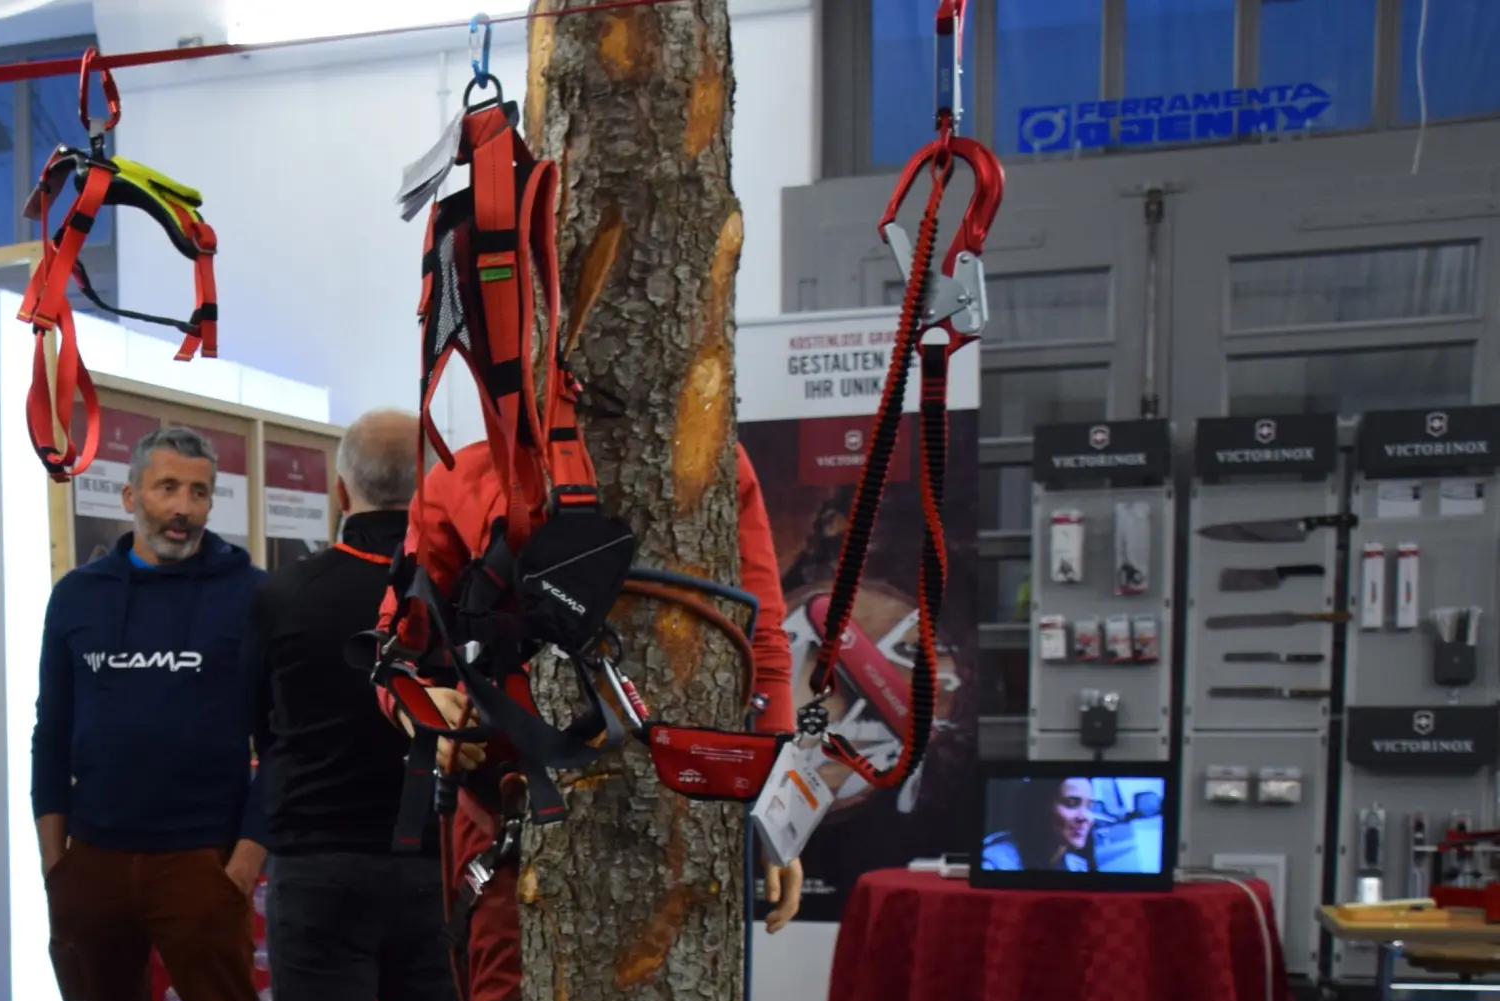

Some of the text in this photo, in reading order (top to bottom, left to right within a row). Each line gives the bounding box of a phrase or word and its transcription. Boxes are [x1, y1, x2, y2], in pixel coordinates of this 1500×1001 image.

[1076, 83, 1330, 123] FERRAMENTA
[788, 351, 885, 376] GESTALTEN
[804, 377, 883, 399] IHR UNIK
[1216, 447, 1315, 464] VICTORINOX
[1384, 440, 1490, 457] VICTORINOX
[1052, 453, 1148, 469] VICTORINOX
[1372, 739, 1474, 753] VICTORINOX
